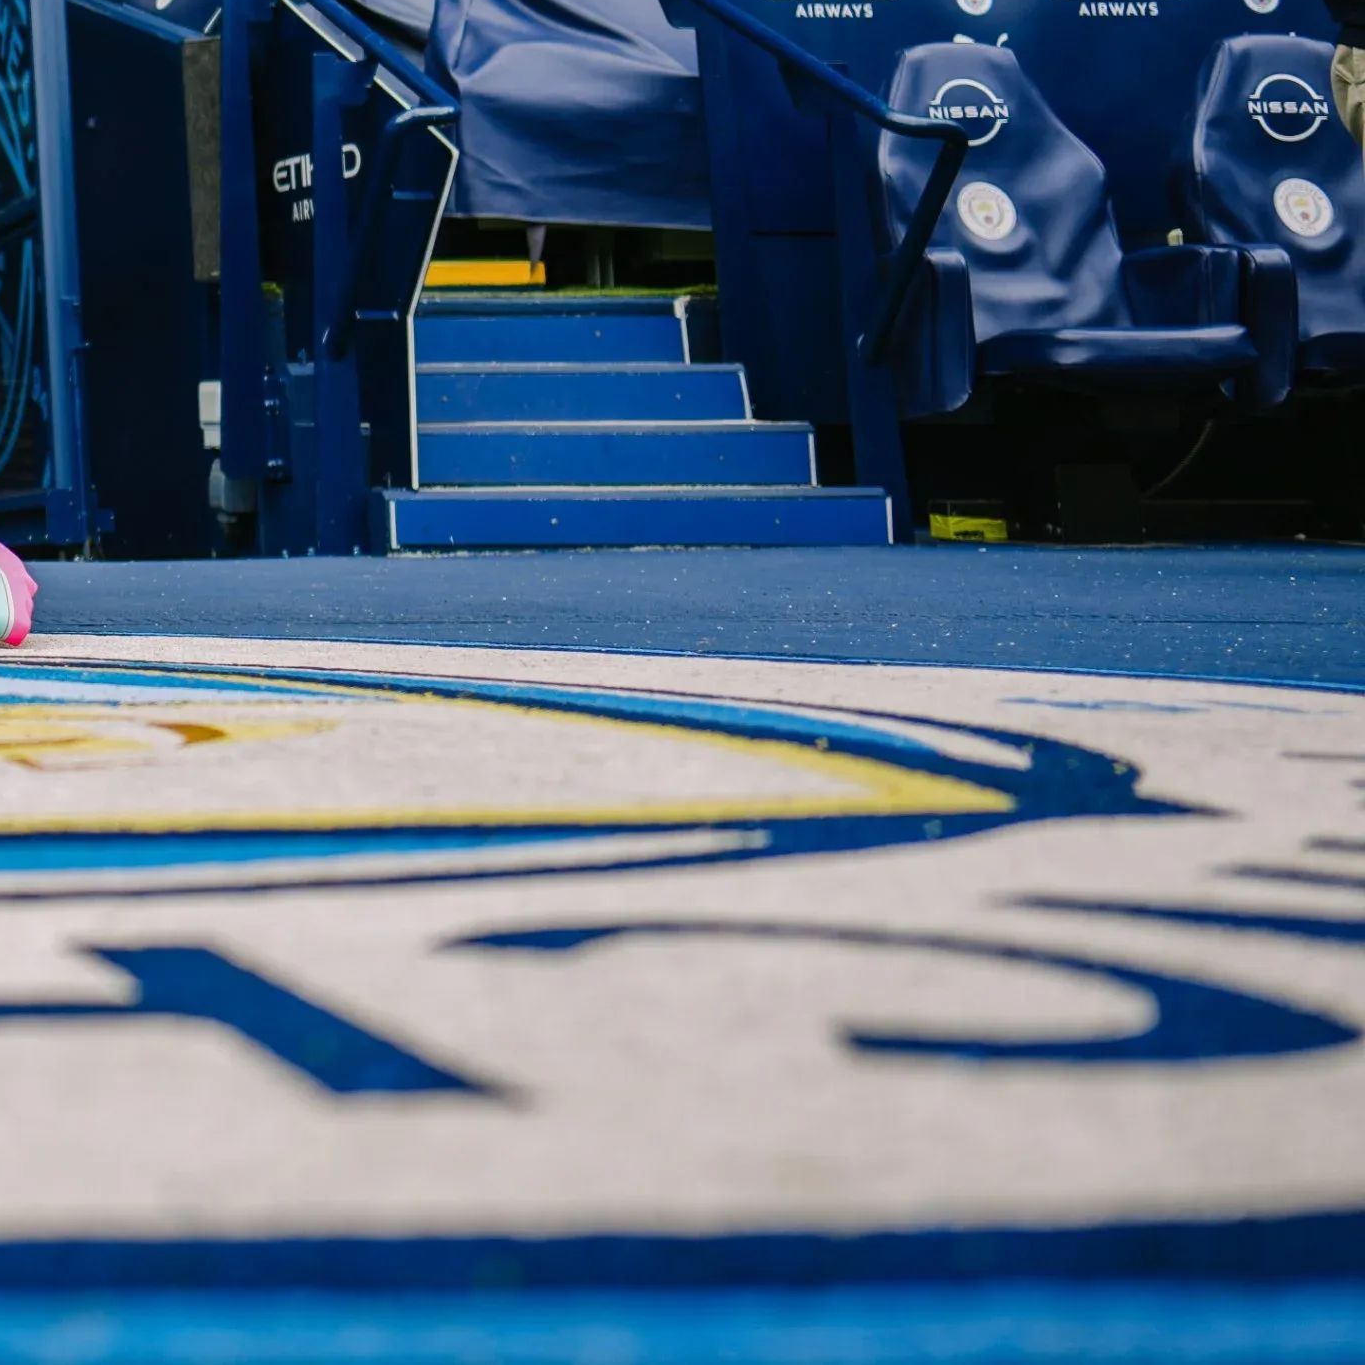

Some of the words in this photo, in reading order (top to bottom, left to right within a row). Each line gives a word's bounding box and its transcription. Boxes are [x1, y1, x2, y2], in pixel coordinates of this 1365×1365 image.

[796, 3, 874, 18] AIRWAYS
[1079, 1, 1159, 16] AIRWAYS
[929, 105, 1009, 120] NISSAN
[1247, 101, 1329, 115] NISSAN
